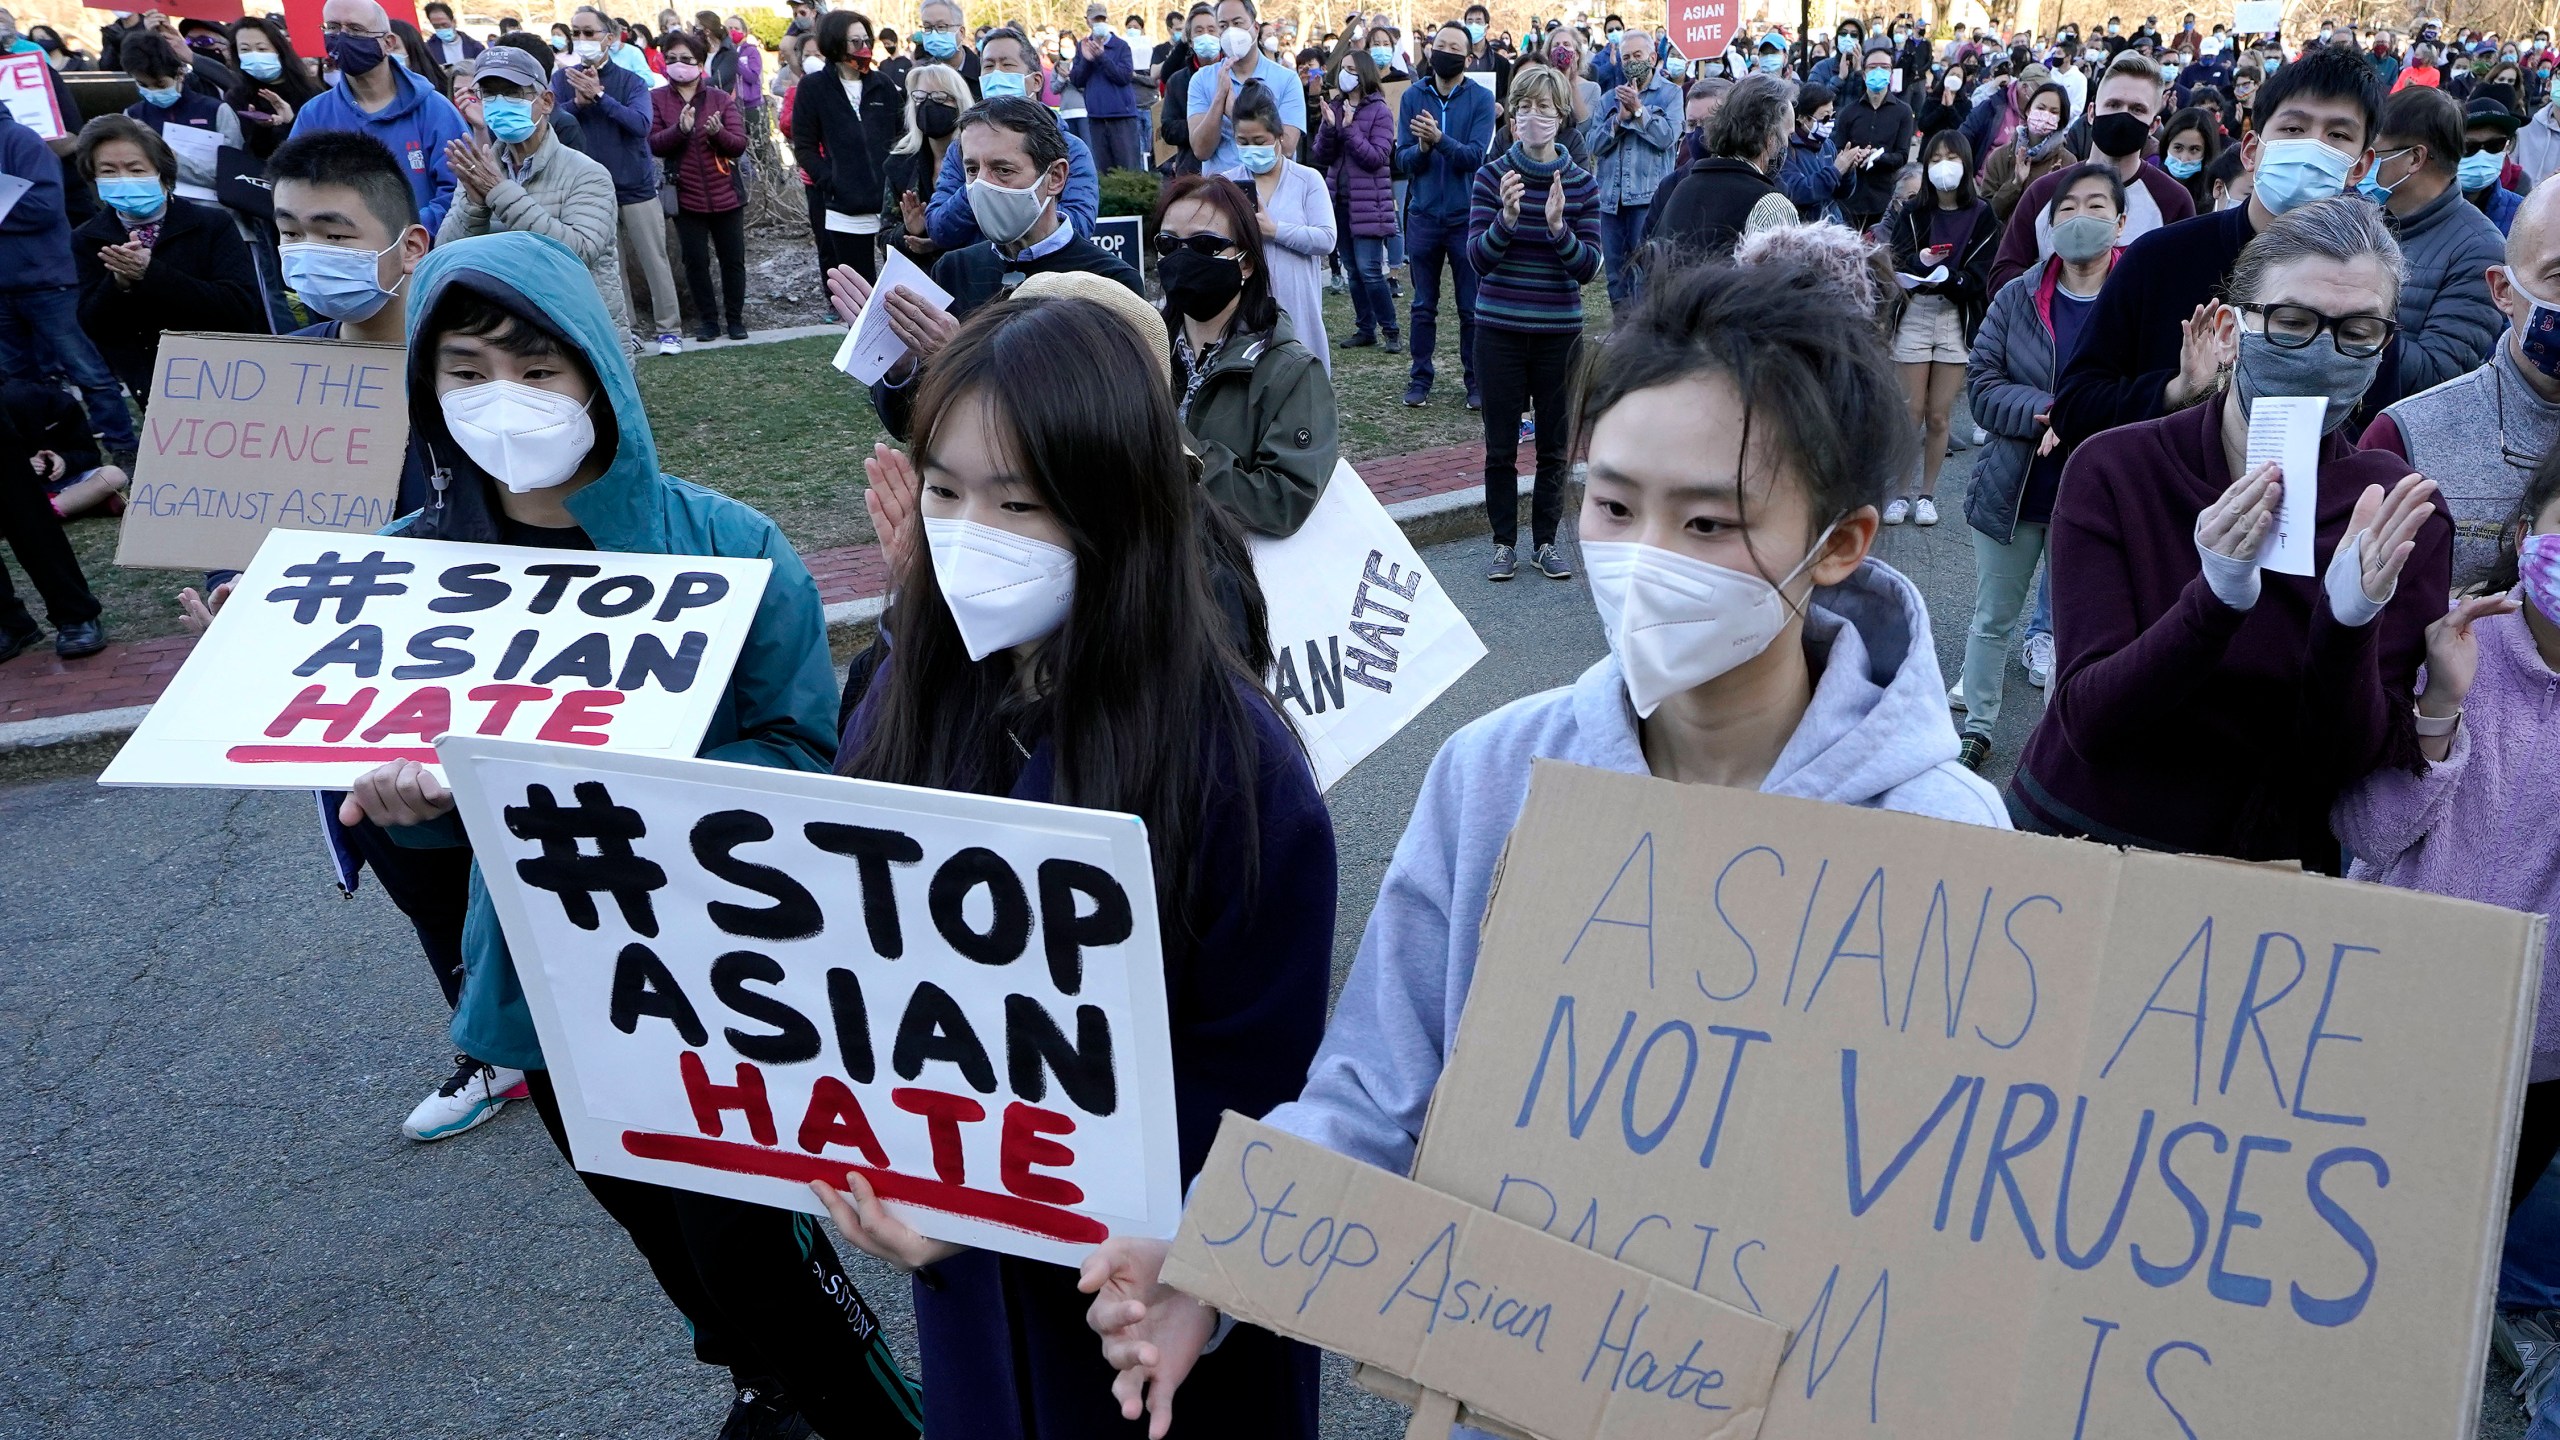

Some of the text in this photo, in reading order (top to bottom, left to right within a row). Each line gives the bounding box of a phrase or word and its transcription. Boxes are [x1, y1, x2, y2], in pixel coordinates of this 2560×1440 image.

[1683, 3, 1725, 21] ASIAN
[1686, 23, 1722, 43] HATE
[1090, 234, 1125, 252] TOP
[164, 357, 390, 409] END THE
[151, 417, 371, 465] VIOENCE
[131, 483, 396, 527] AGAINST ASIAN
[265, 550, 730, 625] #STOP
[1343, 549, 1422, 694] HATE
[292, 624, 709, 693] ASIAN
[264, 684, 625, 745] HATE
[504, 781, 1133, 997] #STOP
[1562, 831, 2380, 1126] ASIANS ARE
[610, 942, 1117, 1117] ASIAN
[680, 1050, 1084, 1205] HATE
[1515, 995, 2391, 1327] NOT VIRUSES
[1201, 1141, 1732, 1411] Stop Asian Hate
